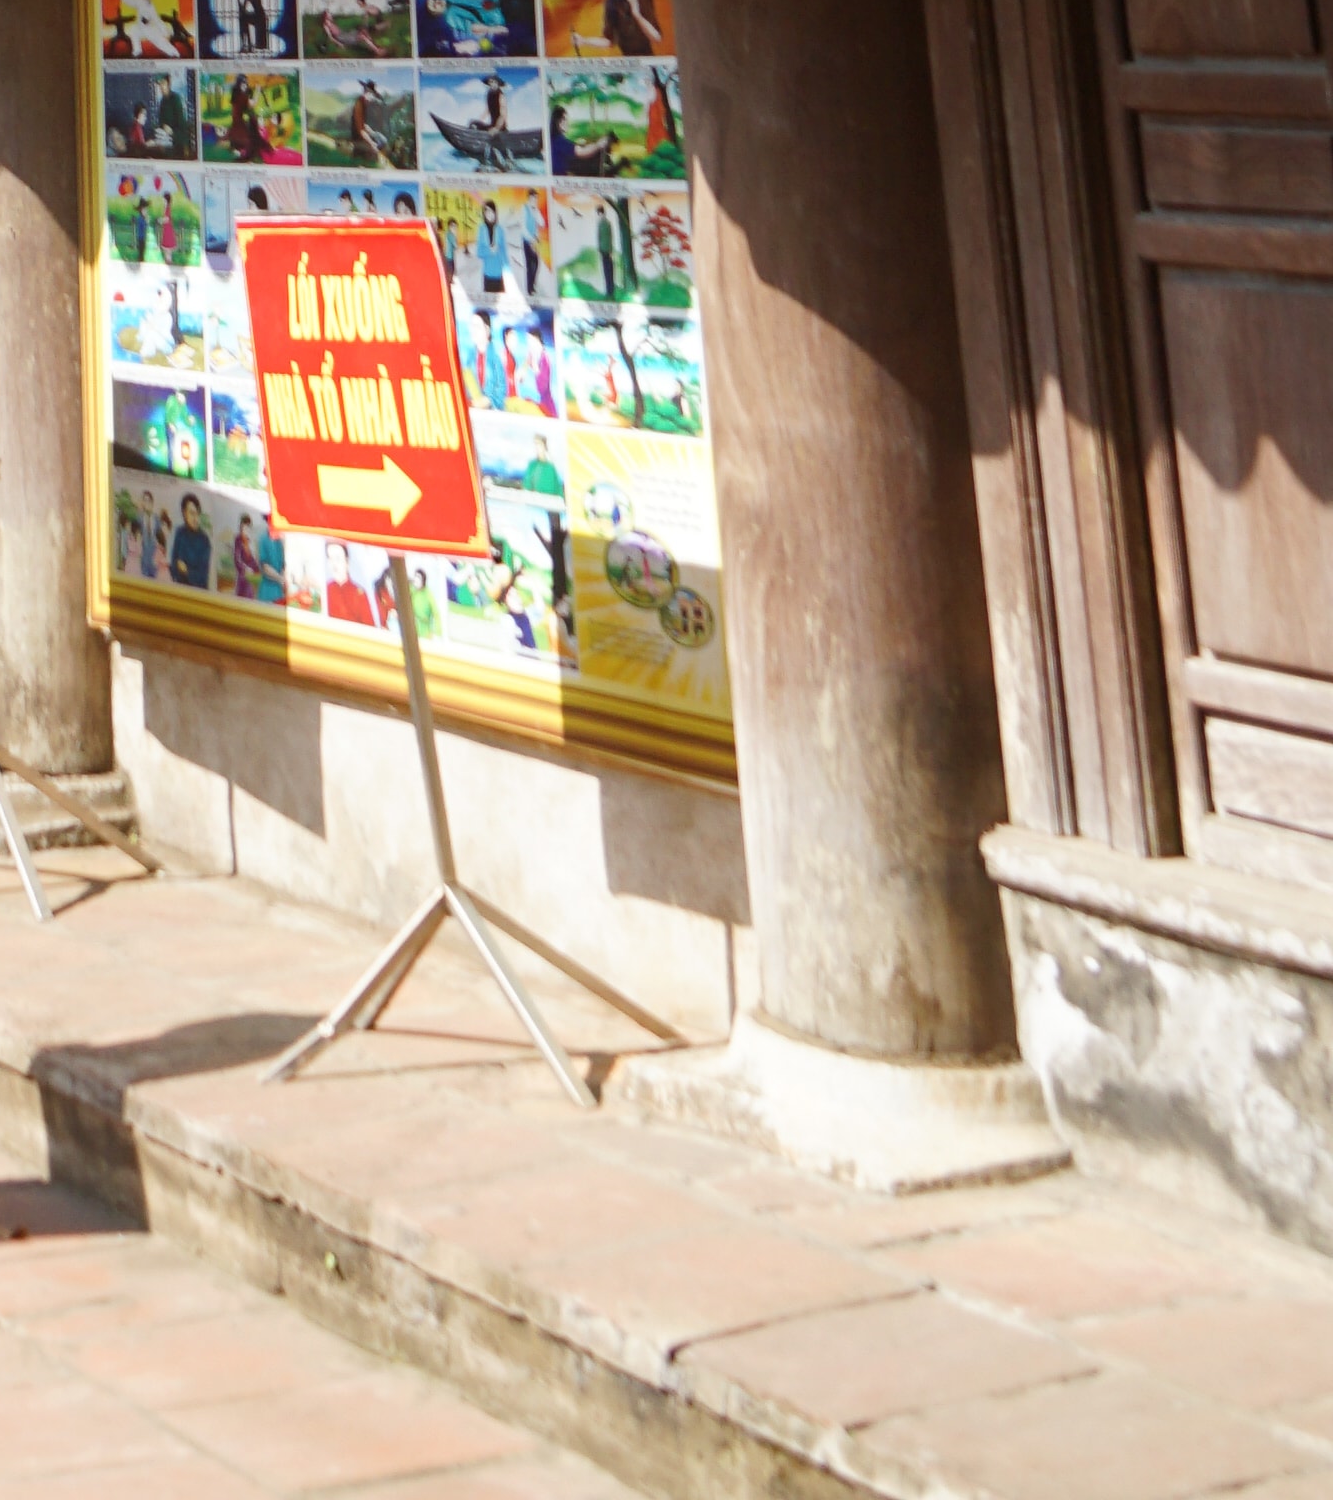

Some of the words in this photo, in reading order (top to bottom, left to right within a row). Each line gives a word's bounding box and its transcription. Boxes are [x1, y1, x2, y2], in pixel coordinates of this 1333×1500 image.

[287, 251, 321, 341] LỐI
[320, 251, 411, 343] XUỐNG
[263, 360, 317, 441] NHÀ
[307, 350, 344, 443] TỔ
[340, 364, 404, 447] NHÀ
